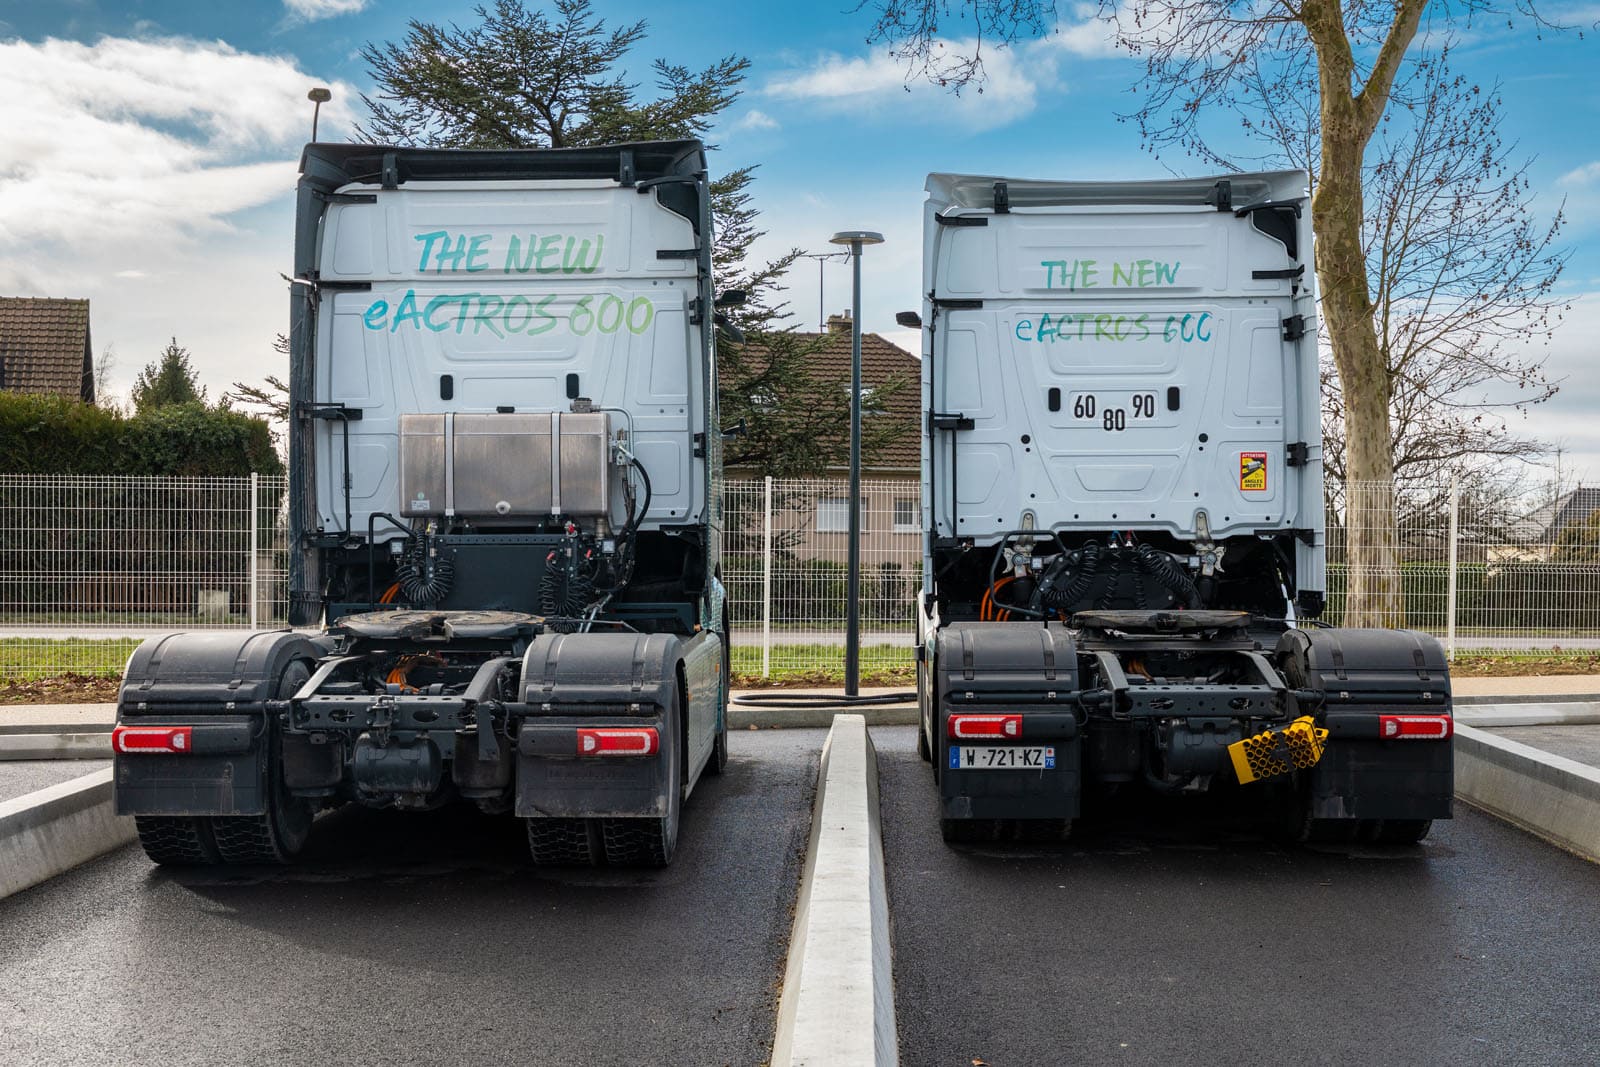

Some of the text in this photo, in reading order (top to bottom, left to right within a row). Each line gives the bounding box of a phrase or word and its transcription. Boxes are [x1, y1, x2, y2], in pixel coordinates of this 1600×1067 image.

[414, 231, 605, 274] THE NEW
[1041, 259, 1181, 292] THE NEW
[364, 290, 654, 340] eACTROS 600
[1015, 312, 1150, 344] eACTROS
[1074, 394, 1155, 418] 60 90
[1103, 408, 1125, 431] 80
